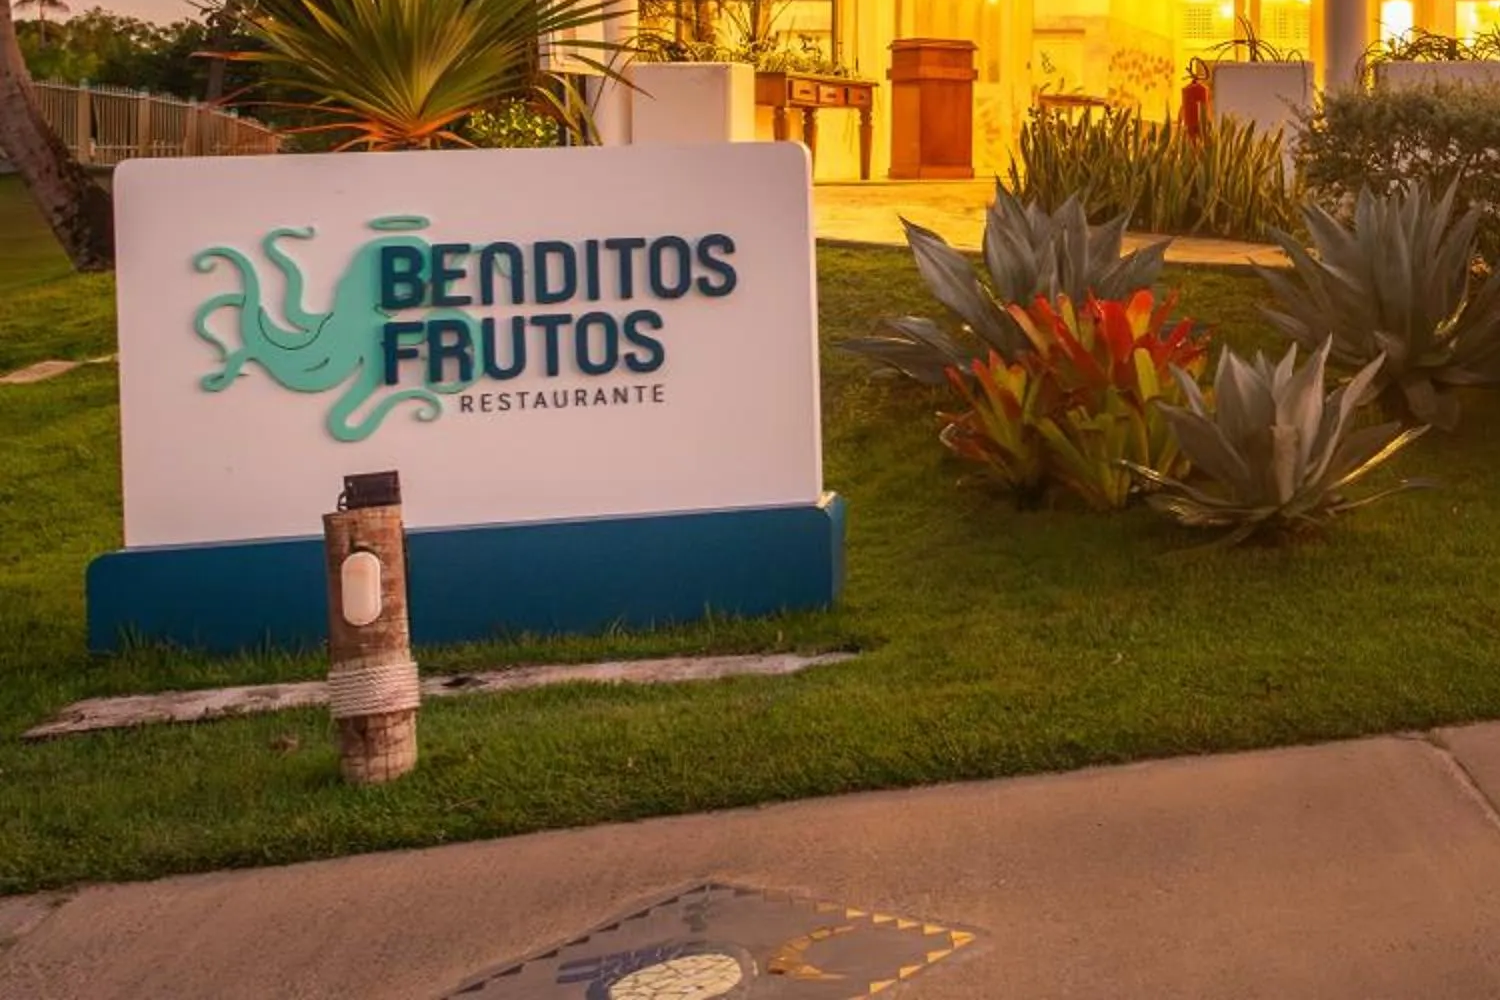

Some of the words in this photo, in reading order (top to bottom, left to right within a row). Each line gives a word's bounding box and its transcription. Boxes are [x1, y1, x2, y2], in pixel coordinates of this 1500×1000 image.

[381, 233, 737, 309] BENDITOS
[382, 309, 665, 386] FRUTOS
[460, 384, 666, 413] RESTAURANTE
